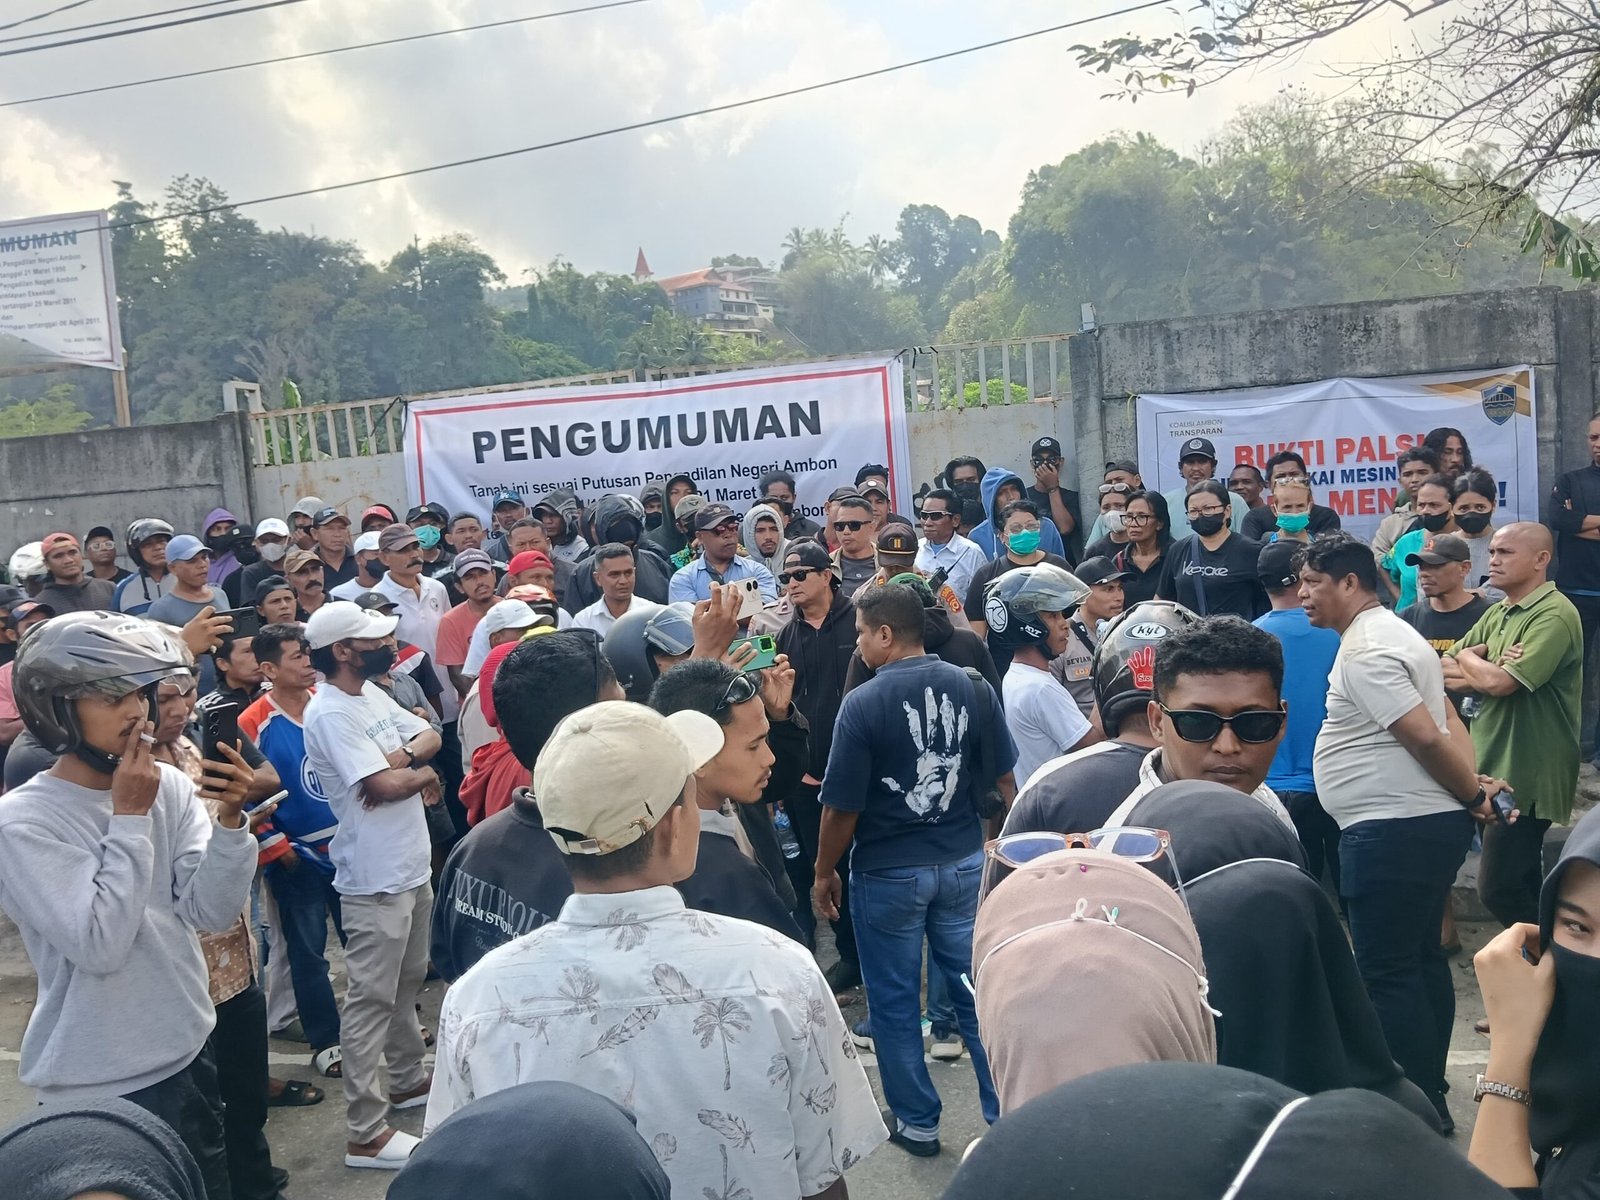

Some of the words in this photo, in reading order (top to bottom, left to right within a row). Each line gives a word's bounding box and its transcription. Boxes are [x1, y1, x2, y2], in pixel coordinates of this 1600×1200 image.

[472, 400, 822, 464] PENGUMUMAN
[1169, 427, 1223, 438] TRANSPARAN
[1197, 418, 1223, 427] AMBON
[513, 482, 529, 497] ini
[533, 477, 578, 494] sesuai
[582, 475, 641, 491] Putusan
[645, 466, 726, 484] Penadilan
[731, 460, 779, 480] Negeri
[784, 457, 838, 474] Ambon
[716, 486, 757, 502] Maret
[1328, 487, 1397, 516] MEN
